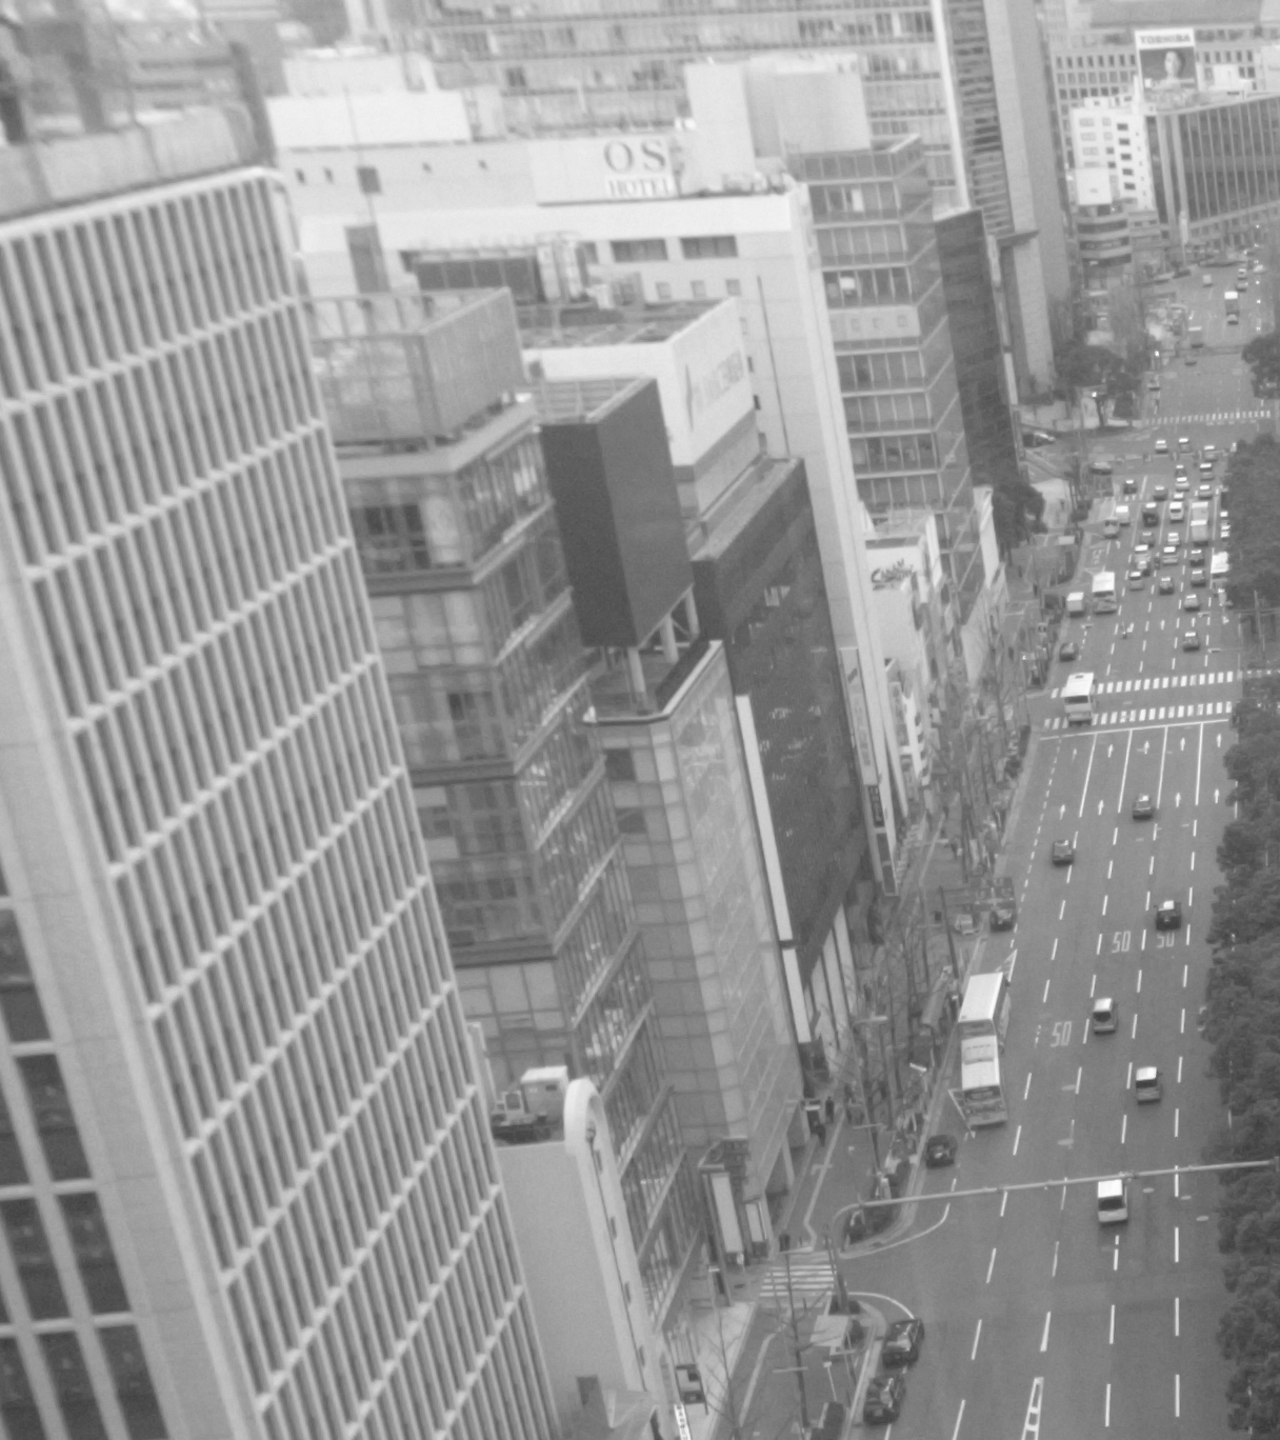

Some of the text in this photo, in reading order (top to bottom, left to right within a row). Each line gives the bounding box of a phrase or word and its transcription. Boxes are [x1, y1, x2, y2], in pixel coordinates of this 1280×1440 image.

[603, 138, 667, 175] OS
[607, 178, 670, 199] HOTEL
[1112, 930, 1132, 954] 50
[1050, 1020, 1072, 1048] 50
